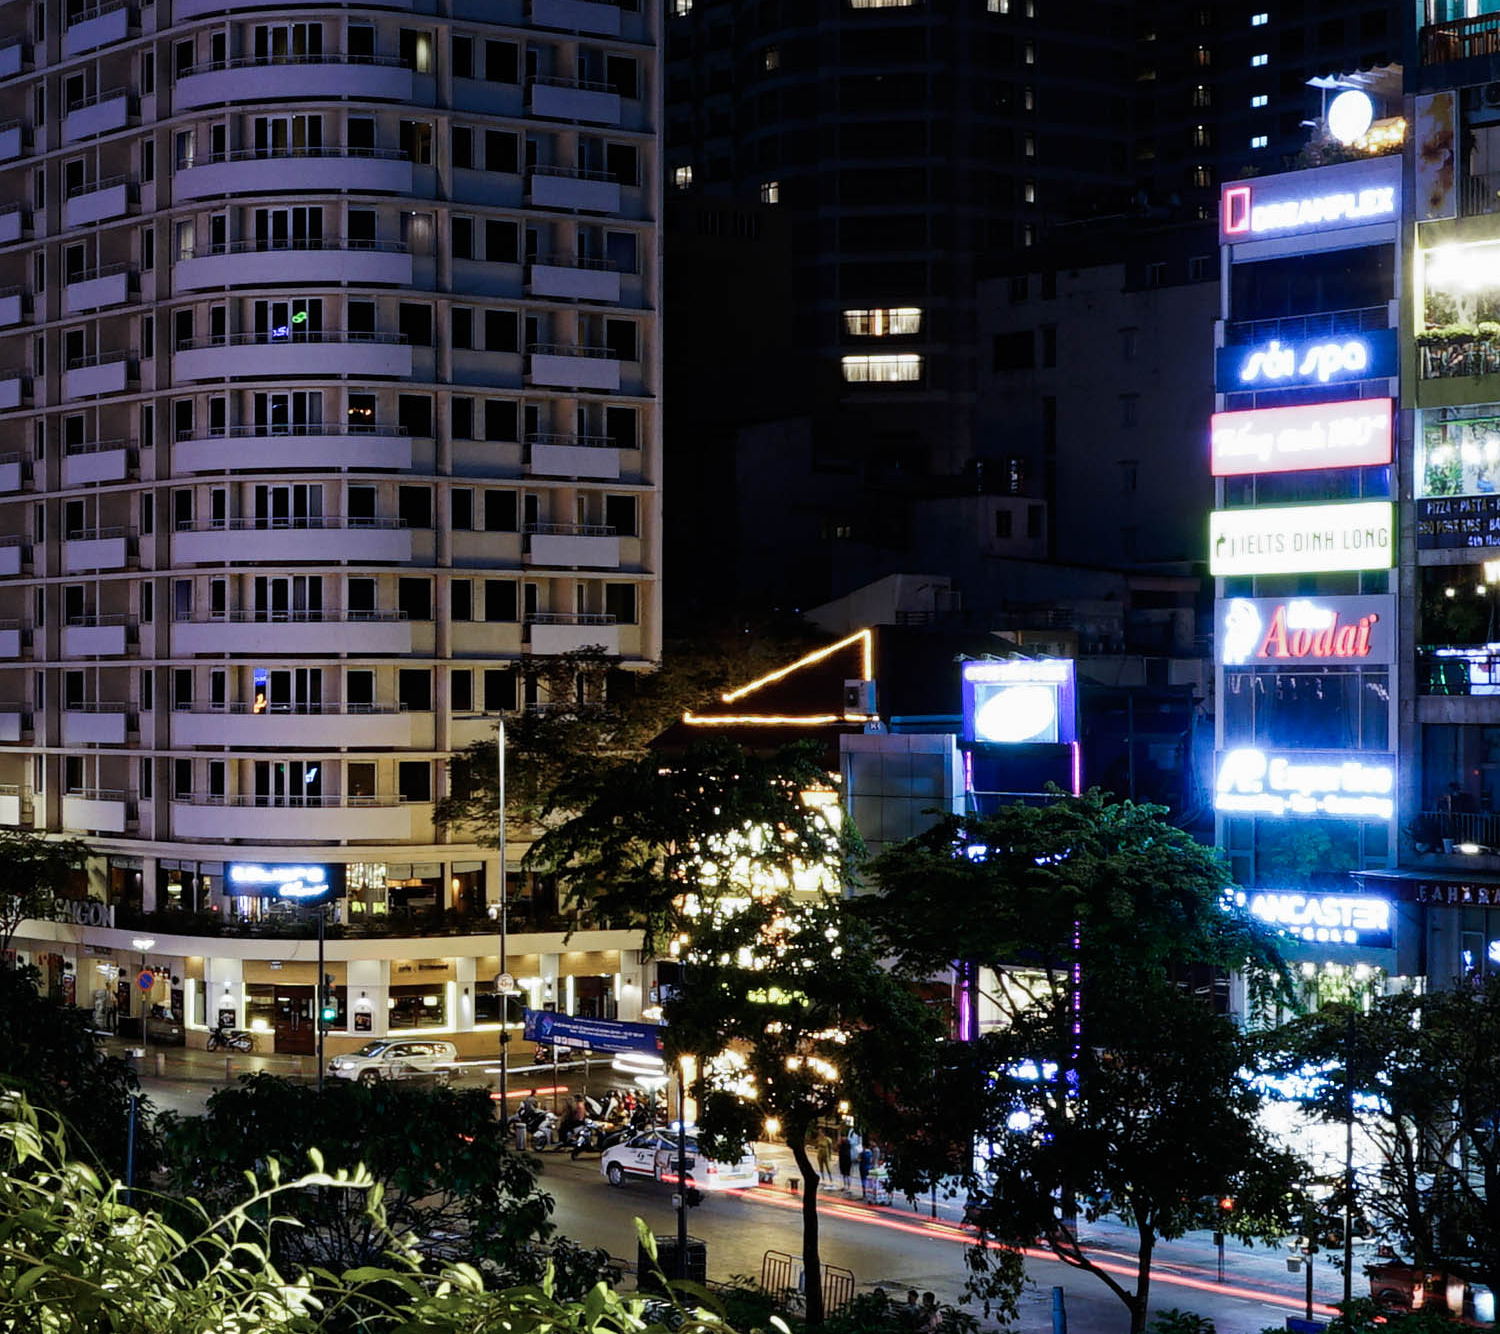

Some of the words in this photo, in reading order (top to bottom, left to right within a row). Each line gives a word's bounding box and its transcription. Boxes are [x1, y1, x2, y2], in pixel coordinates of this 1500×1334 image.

[1426, 501, 1451, 515] PIZZA
[1460, 498, 1487, 513] PASTA
[1240, 533, 1286, 556] IELTS
[1343, 528, 1388, 549] LONG
[52, 897, 116, 928] SAIGON
